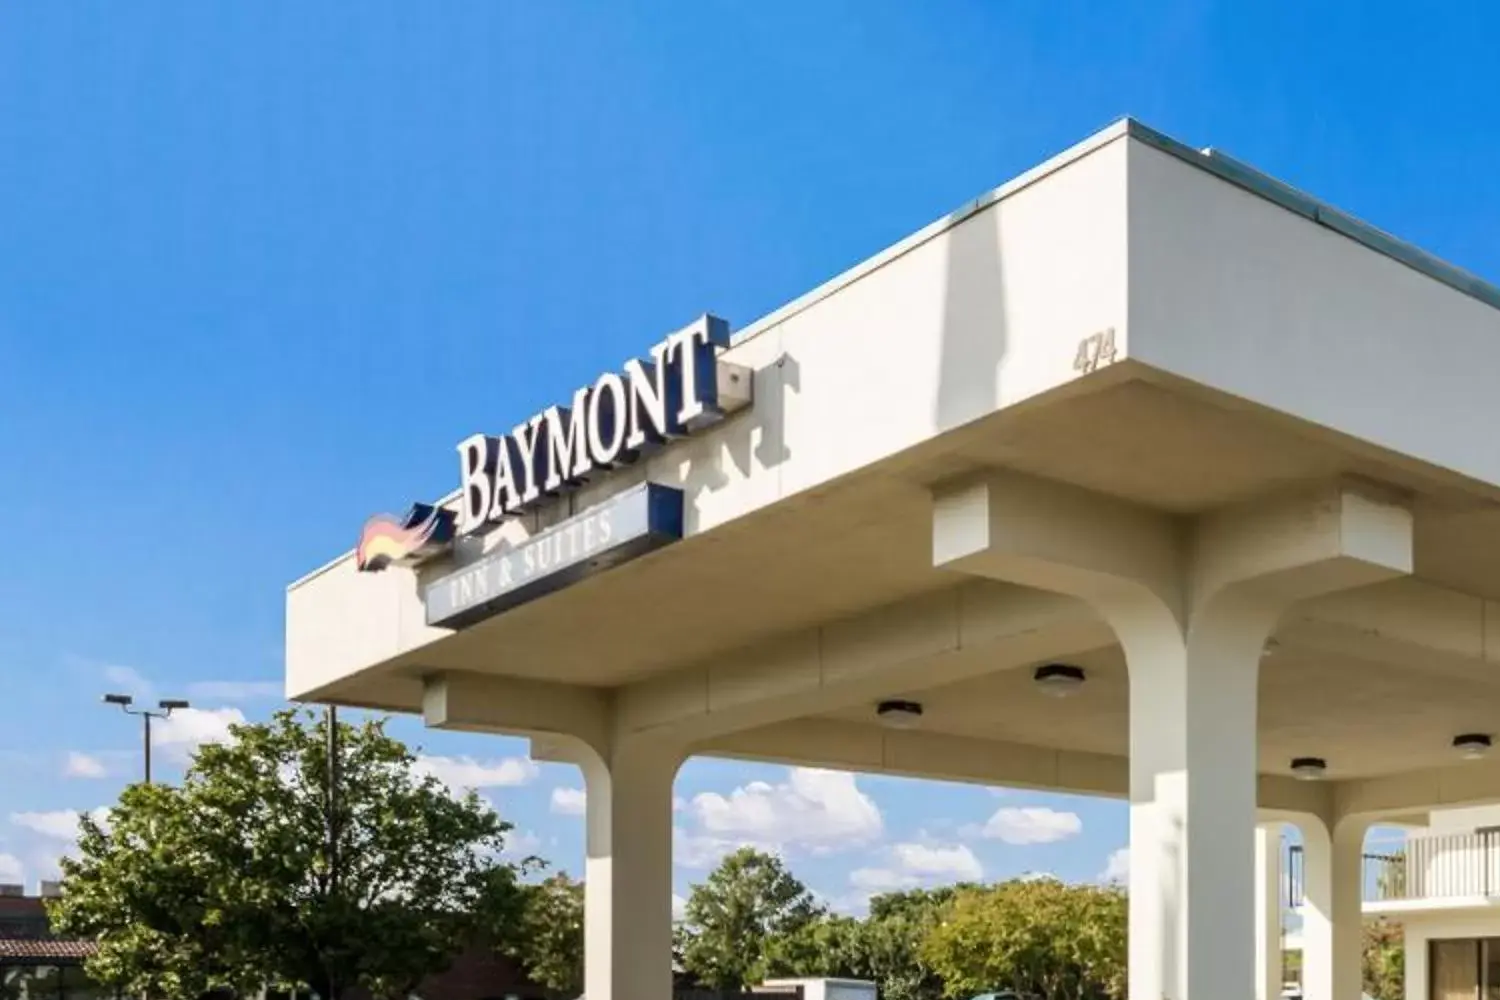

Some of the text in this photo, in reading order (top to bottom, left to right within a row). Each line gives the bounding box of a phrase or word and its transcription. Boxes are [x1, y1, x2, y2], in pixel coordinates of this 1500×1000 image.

[453, 313, 718, 535] BAYMONT
[451, 509, 612, 609] INN & SUITES
